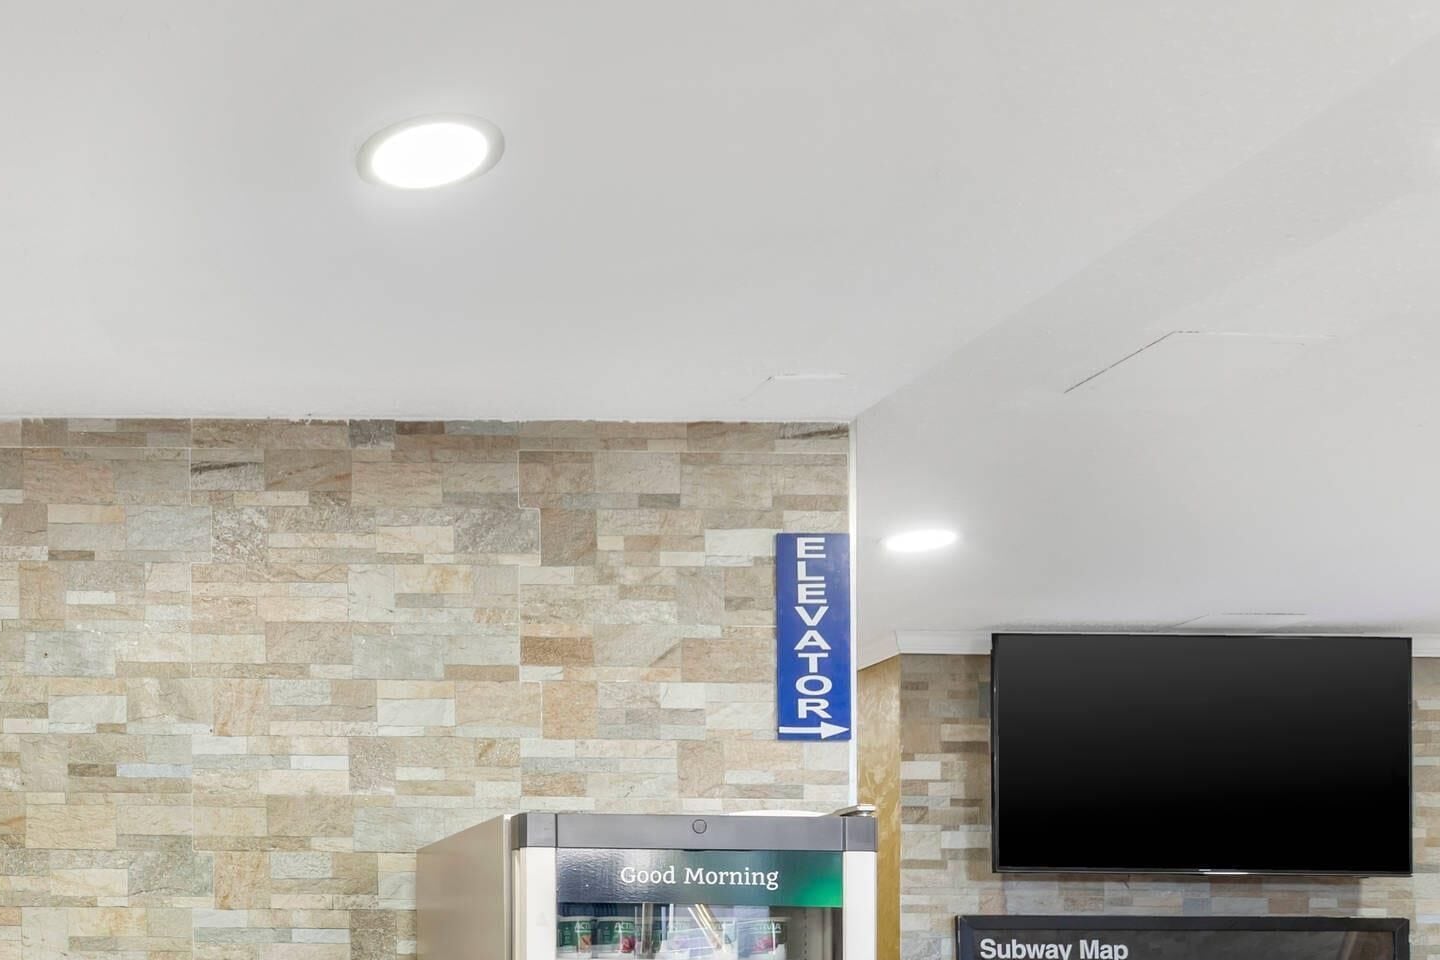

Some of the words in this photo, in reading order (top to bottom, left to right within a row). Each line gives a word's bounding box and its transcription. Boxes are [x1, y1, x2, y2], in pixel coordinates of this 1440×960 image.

[793, 536, 833, 720] ELEVATOR
[620, 865, 677, 885] Good
[683, 867, 780, 891] Morning
